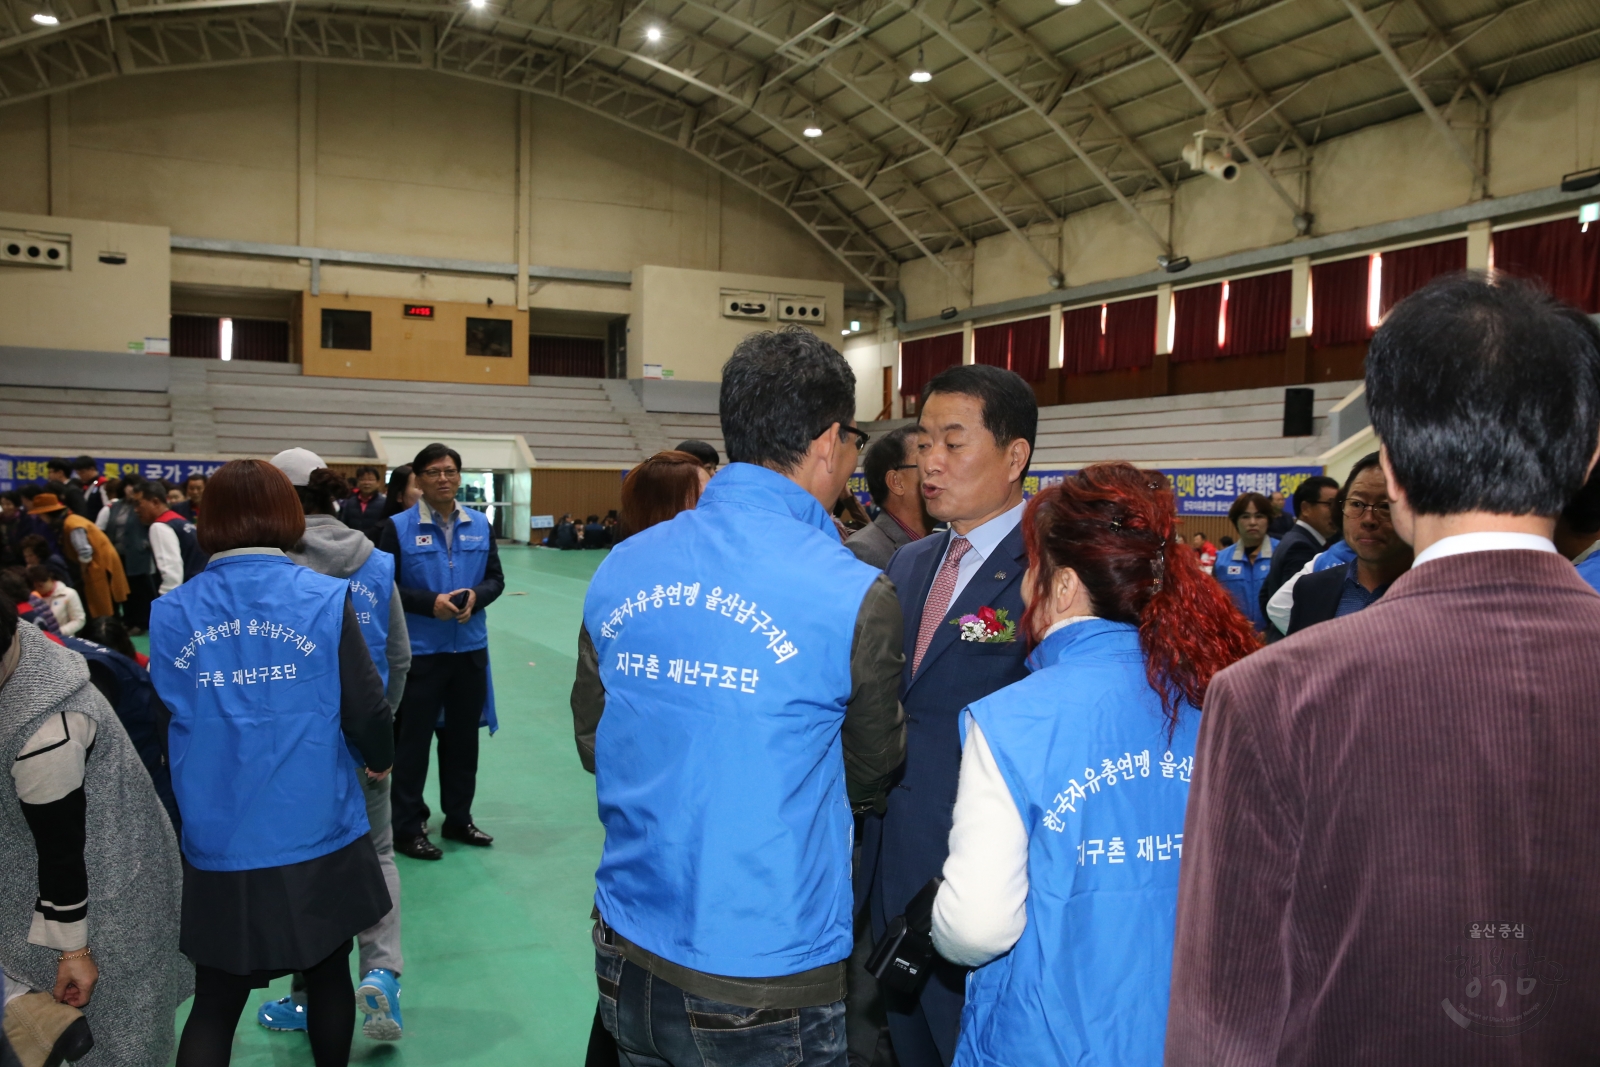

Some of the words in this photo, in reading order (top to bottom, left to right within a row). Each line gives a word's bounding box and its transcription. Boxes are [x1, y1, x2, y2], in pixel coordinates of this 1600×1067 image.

[145, 464, 182, 483] 국가
[1176, 474, 1196, 497] 인재
[1196, 474, 1235, 498] 양성으로
[246, 618, 316, 657] 울산남구지회
[600, 581, 700, 640] 한국자유총연맹
[705, 586, 799, 664] 울산남구지회
[232, 663, 297, 686] 재난구조단
[616, 651, 660, 680] 지구촌
[667, 658, 760, 694] 재난구조단
[1042, 749, 1150, 833] 한국자유총연맹
